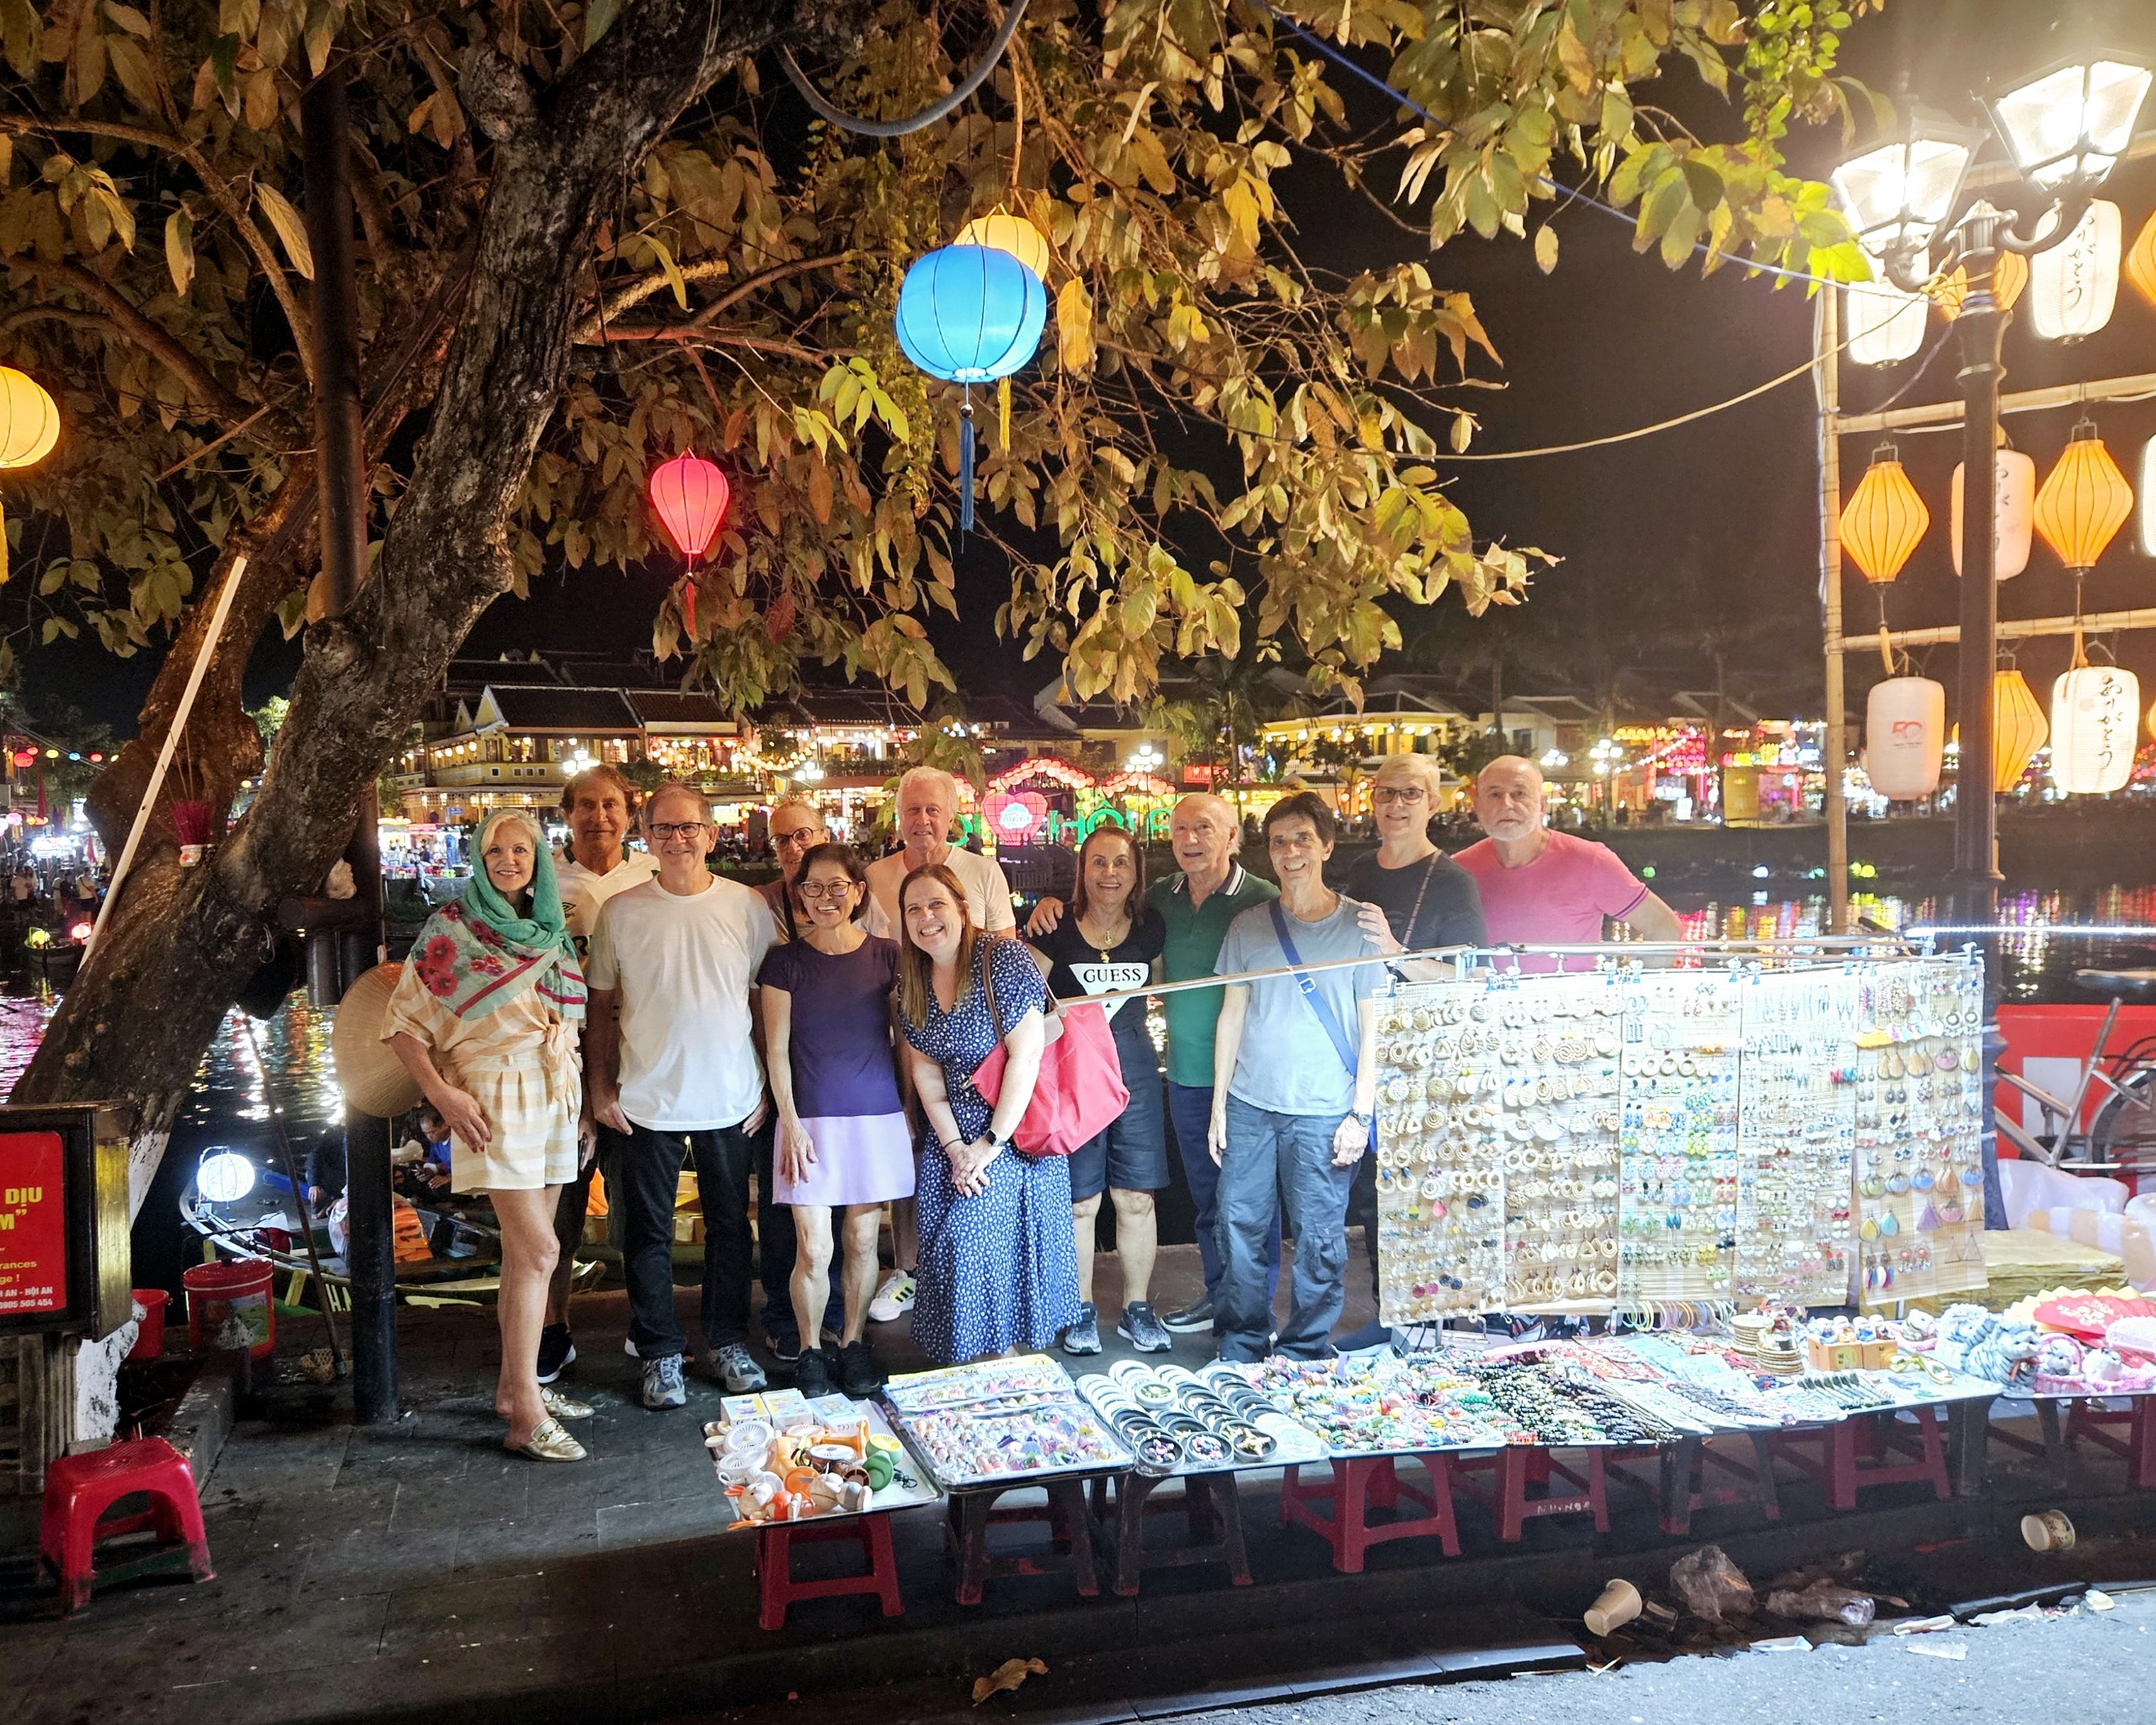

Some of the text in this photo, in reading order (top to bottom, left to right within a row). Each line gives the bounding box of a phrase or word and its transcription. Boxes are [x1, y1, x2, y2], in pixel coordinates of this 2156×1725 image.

[1083, 968, 1142, 983] GUESS
[5, 1186, 42, 1207] DỊU
[40, 1286, 53, 1295] AN
